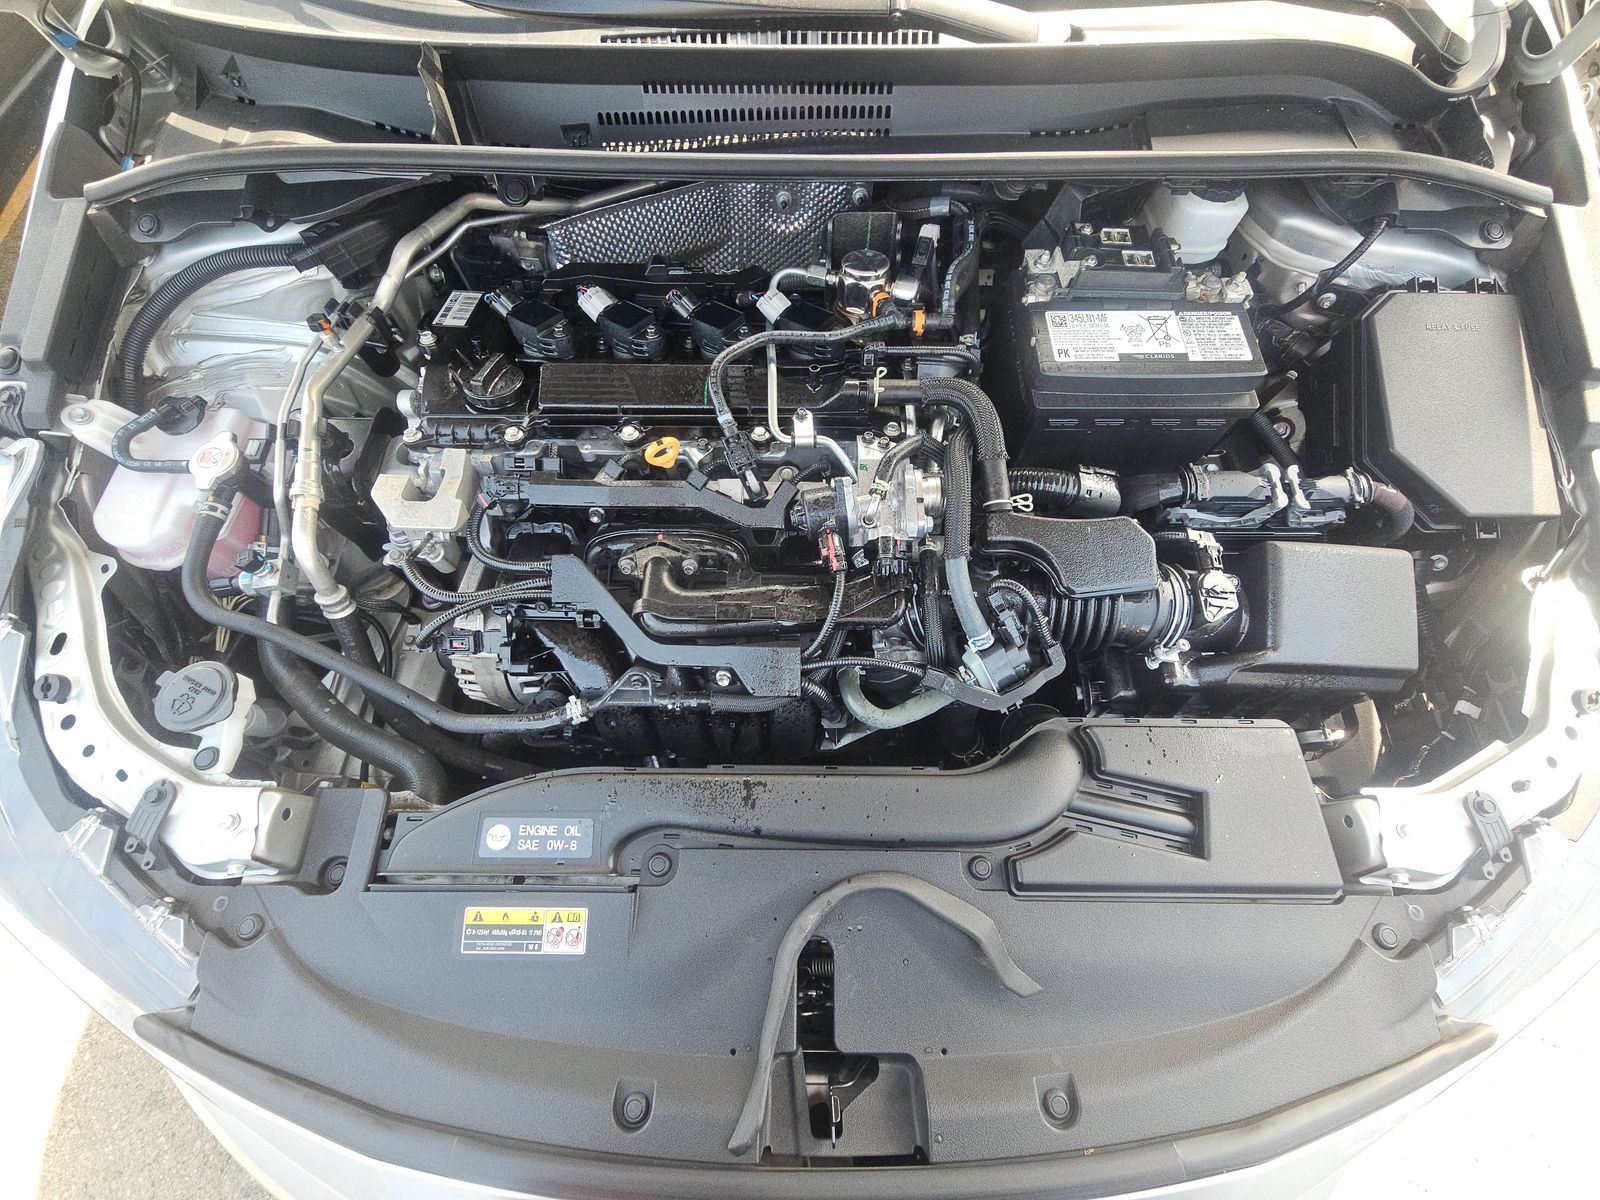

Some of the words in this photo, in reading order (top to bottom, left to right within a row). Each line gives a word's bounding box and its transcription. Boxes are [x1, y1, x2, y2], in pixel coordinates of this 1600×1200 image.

[1069, 313, 1108, 323] 345LN1-MF
[1425, 323, 1450, 331] RELAY
[1460, 323, 1480, 331] FUSE
[1158, 340, 1171, 348] Pb
[1057, 348, 1071, 358] PK
[518, 824, 558, 836] ENGINE
[564, 825, 581, 837] OIL
[517, 840, 540, 851] SAE
[546, 840, 578, 851] 0W-8
